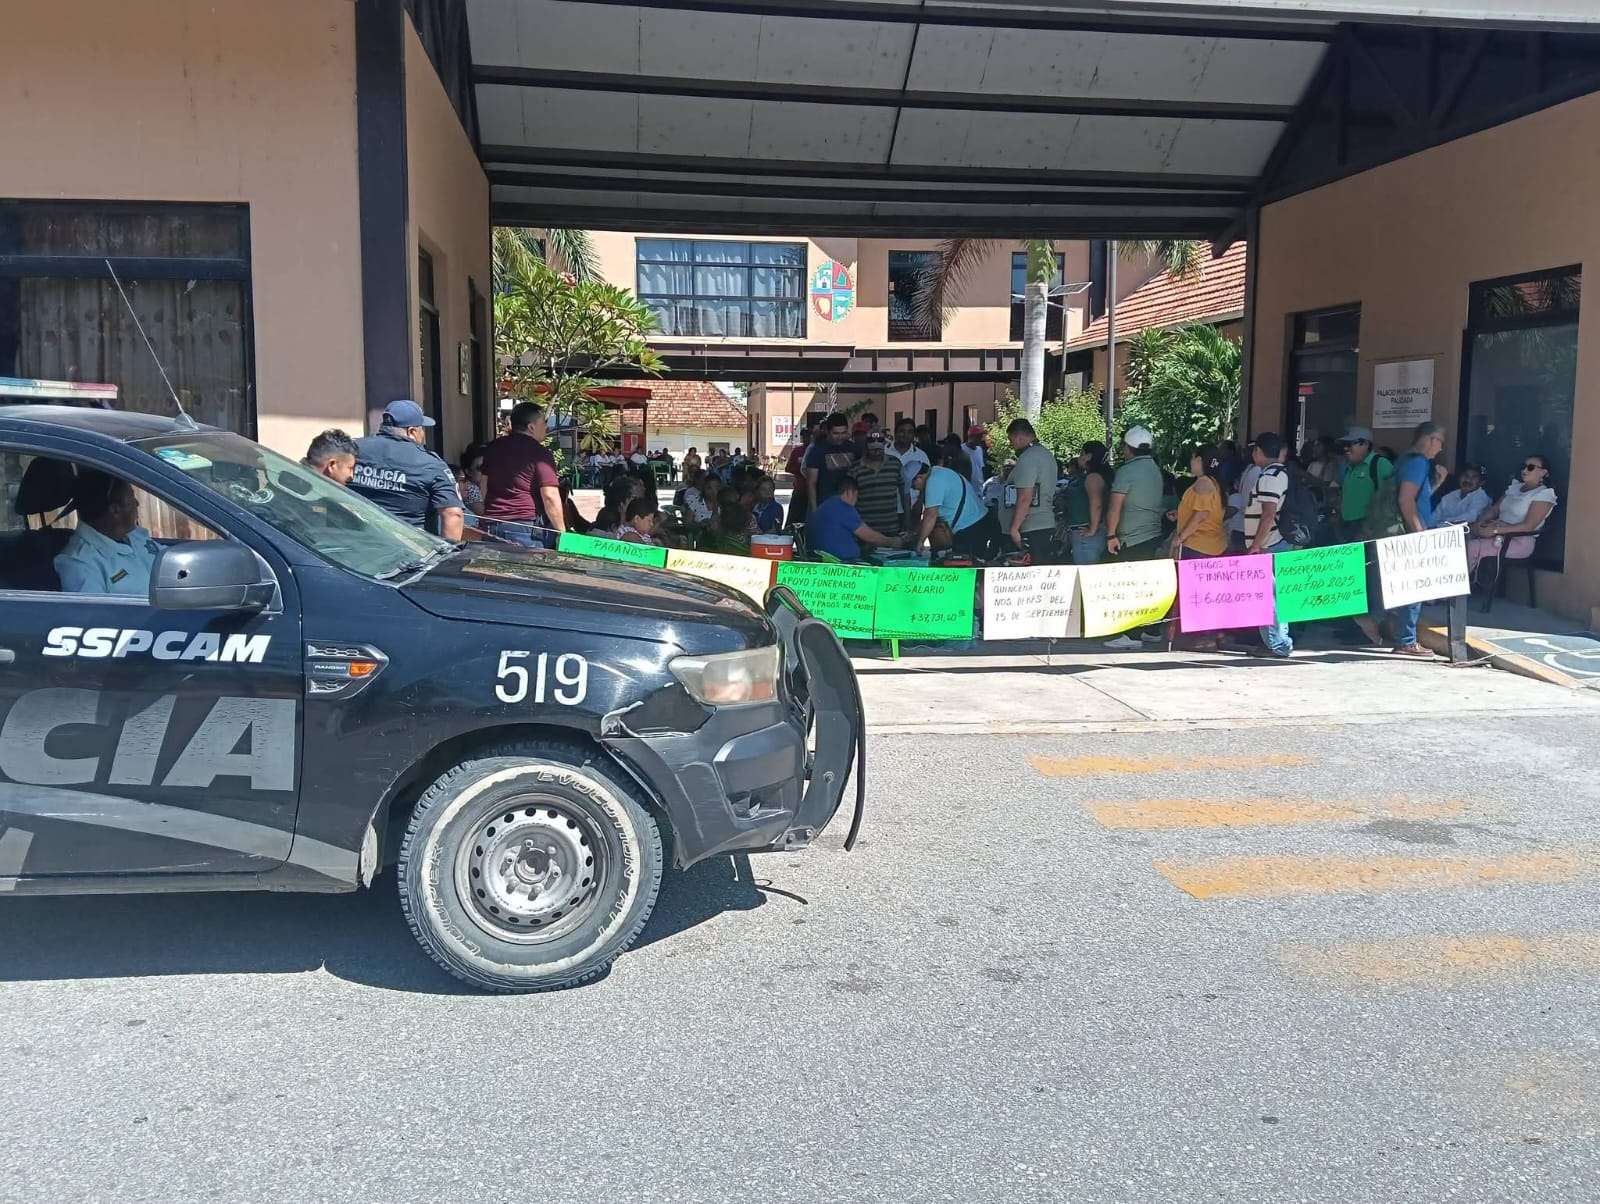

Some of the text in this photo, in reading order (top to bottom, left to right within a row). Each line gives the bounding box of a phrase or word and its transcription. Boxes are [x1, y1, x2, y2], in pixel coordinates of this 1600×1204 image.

[354, 464, 407, 484] POLICÍA
[353, 475, 406, 492] MUNICIPAL
[1431, 529, 1463, 550] TOTAL
[1047, 568, 1061, 578] LA
[1195, 569, 1266, 582] FINANCIERAS
[812, 579, 856, 590] FUNERARIO
[993, 582, 1057, 594] QUINCENA QUE
[1327, 575, 1355, 588] 2025
[884, 583, 945, 594] DE SALARIO
[994, 597, 1012, 607] NOS
[1049, 595, 1066, 604] DEL
[42, 626, 272, 663] SSPCAM
[495, 650, 588, 706] 519
